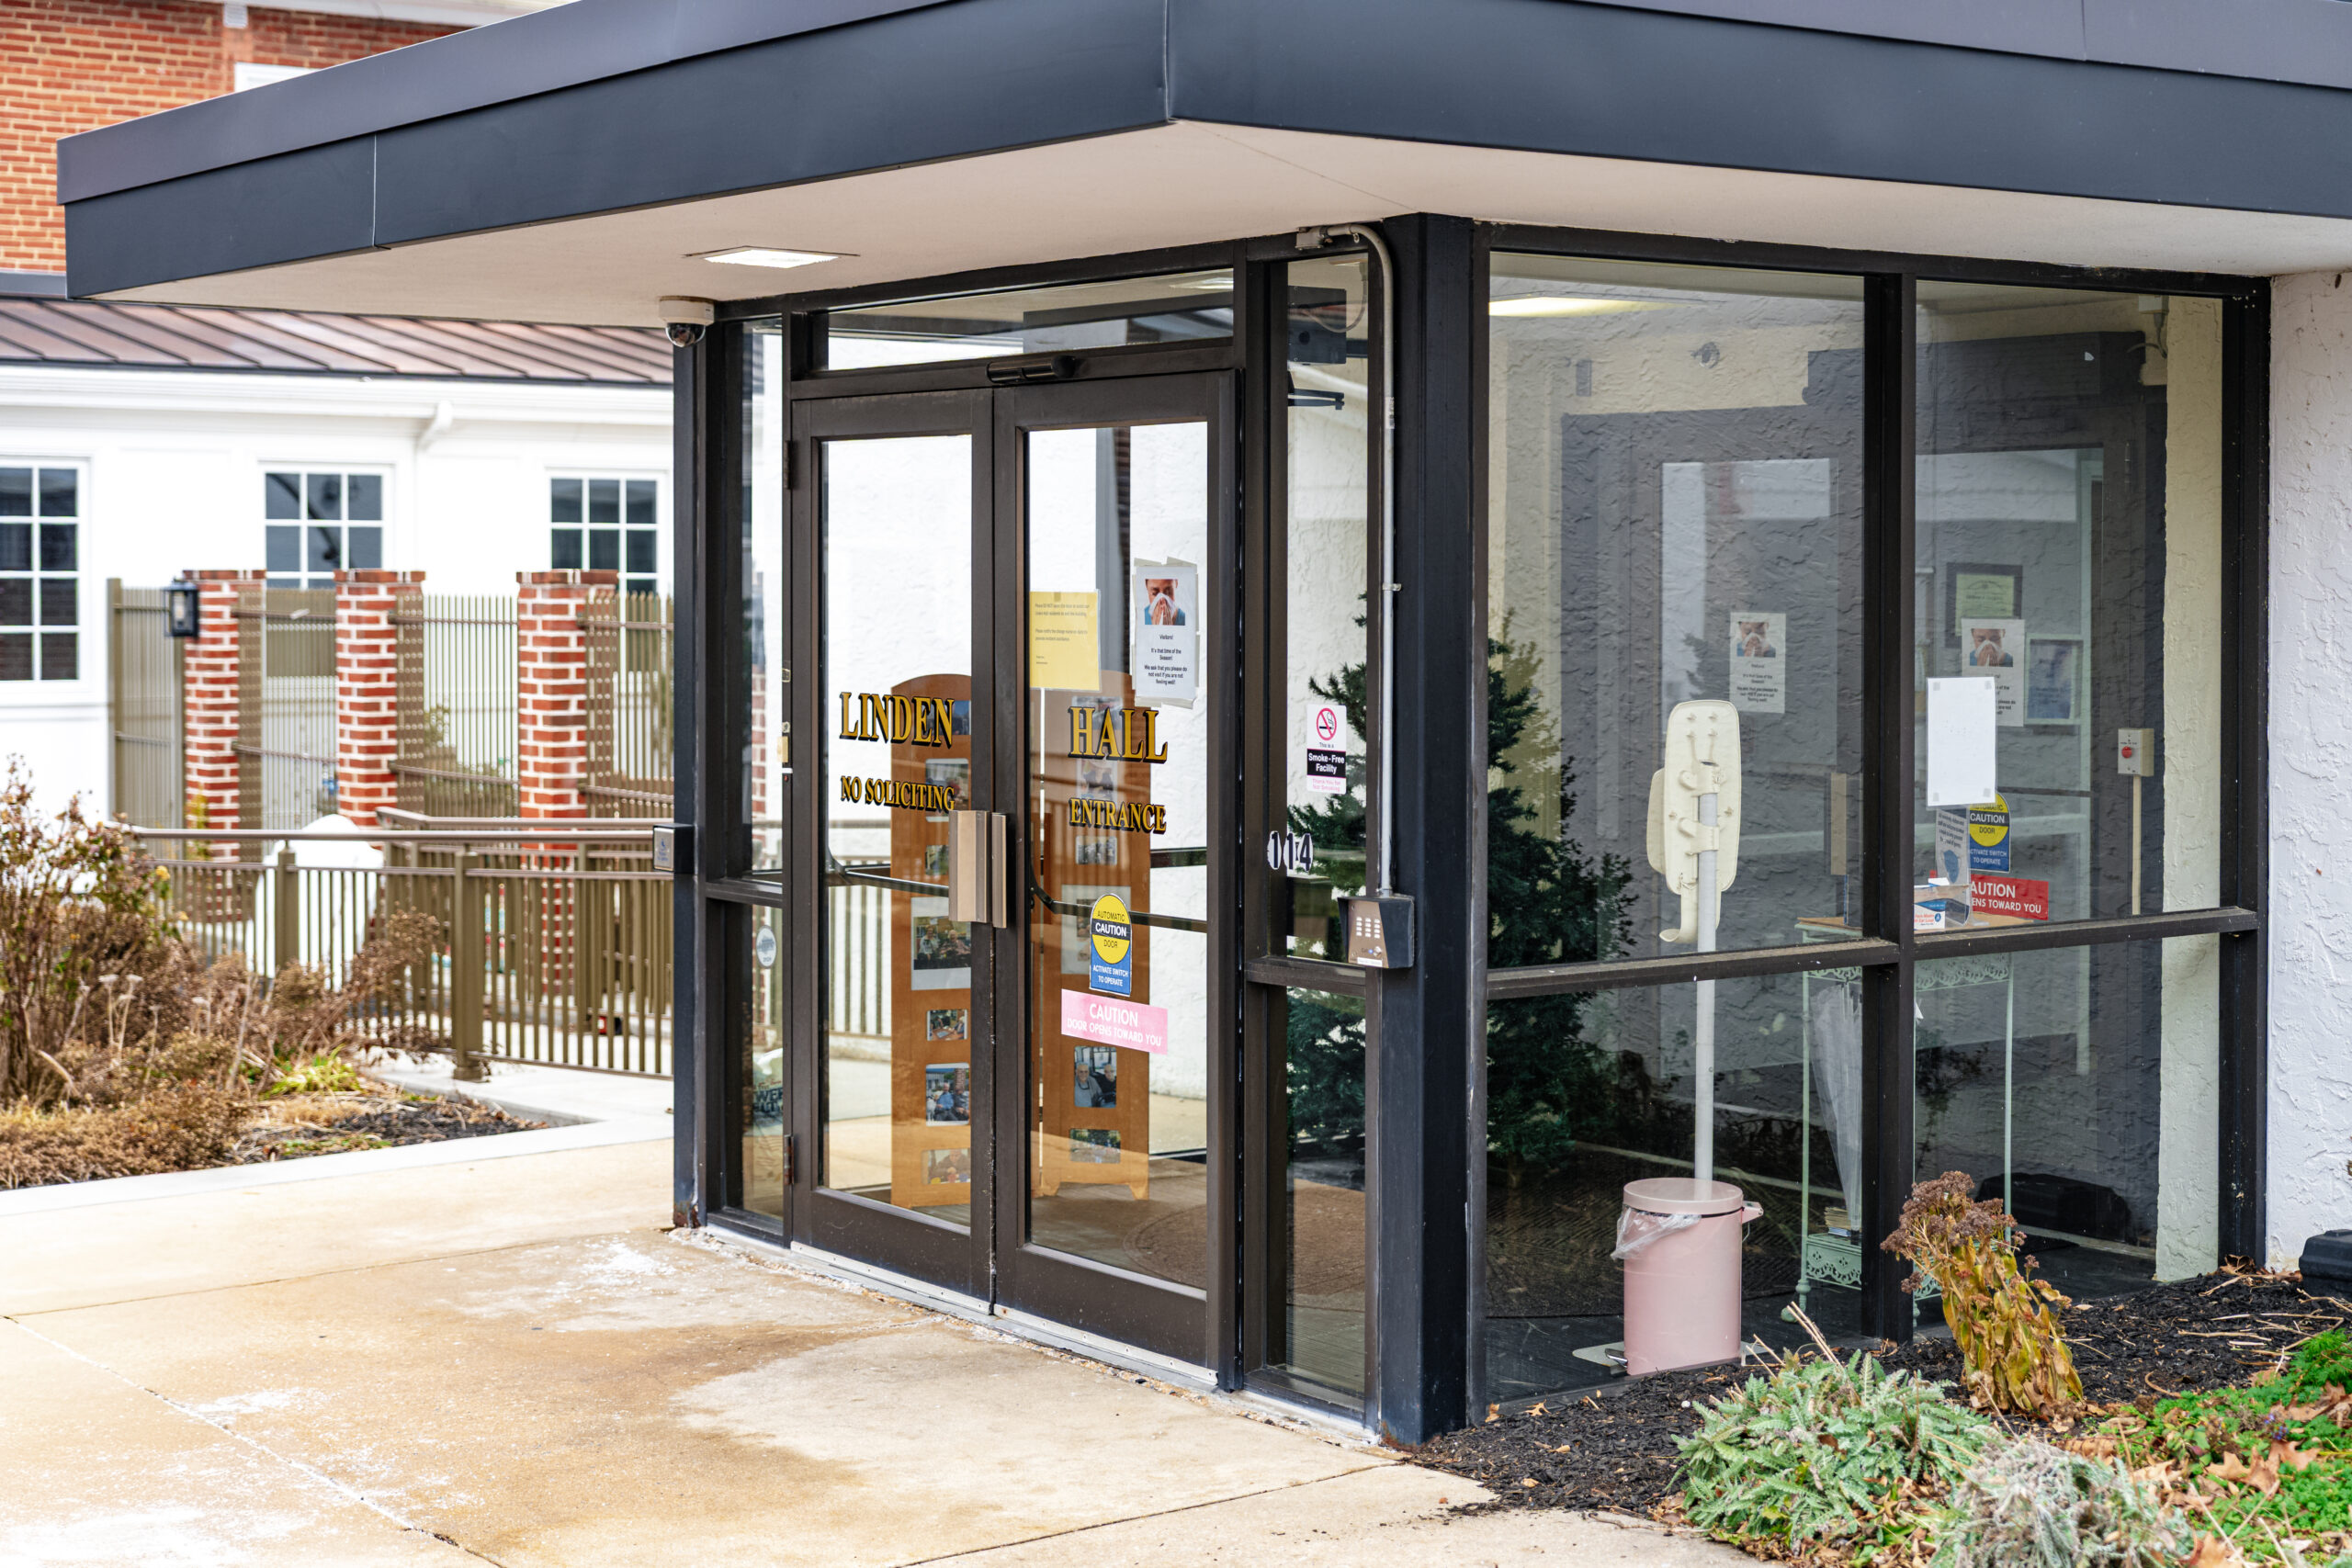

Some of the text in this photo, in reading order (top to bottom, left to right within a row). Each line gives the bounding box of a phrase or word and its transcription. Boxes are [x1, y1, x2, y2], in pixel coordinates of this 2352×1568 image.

[839, 692, 955, 749] LINDEN
[1068, 706, 1168, 764] HALL
[1316, 763, 1338, 775] Facility
[841, 775, 956, 814] NO SOLICITING
[1069, 797, 1167, 834] ENTRANCE
[1970, 812, 2005, 824] CAUTION
[1272, 831, 1311, 871] 114
[1971, 880, 2016, 898] AUTION
[1972, 897, 2041, 914] ENS TOWARD YOU
[1097, 910, 1125, 922] AUTOMATIC
[1095, 922, 1127, 937] CAUTION
[1103, 939, 1118, 949] DOOR
[1092, 964, 1129, 978] ACTIVATE SWITCH
[1098, 975, 1123, 987] TO OPERATE
[1090, 1003, 1138, 1027] CAUTION
[1067, 1018, 1161, 1046] DOOR OPENS TOWARD YOU
